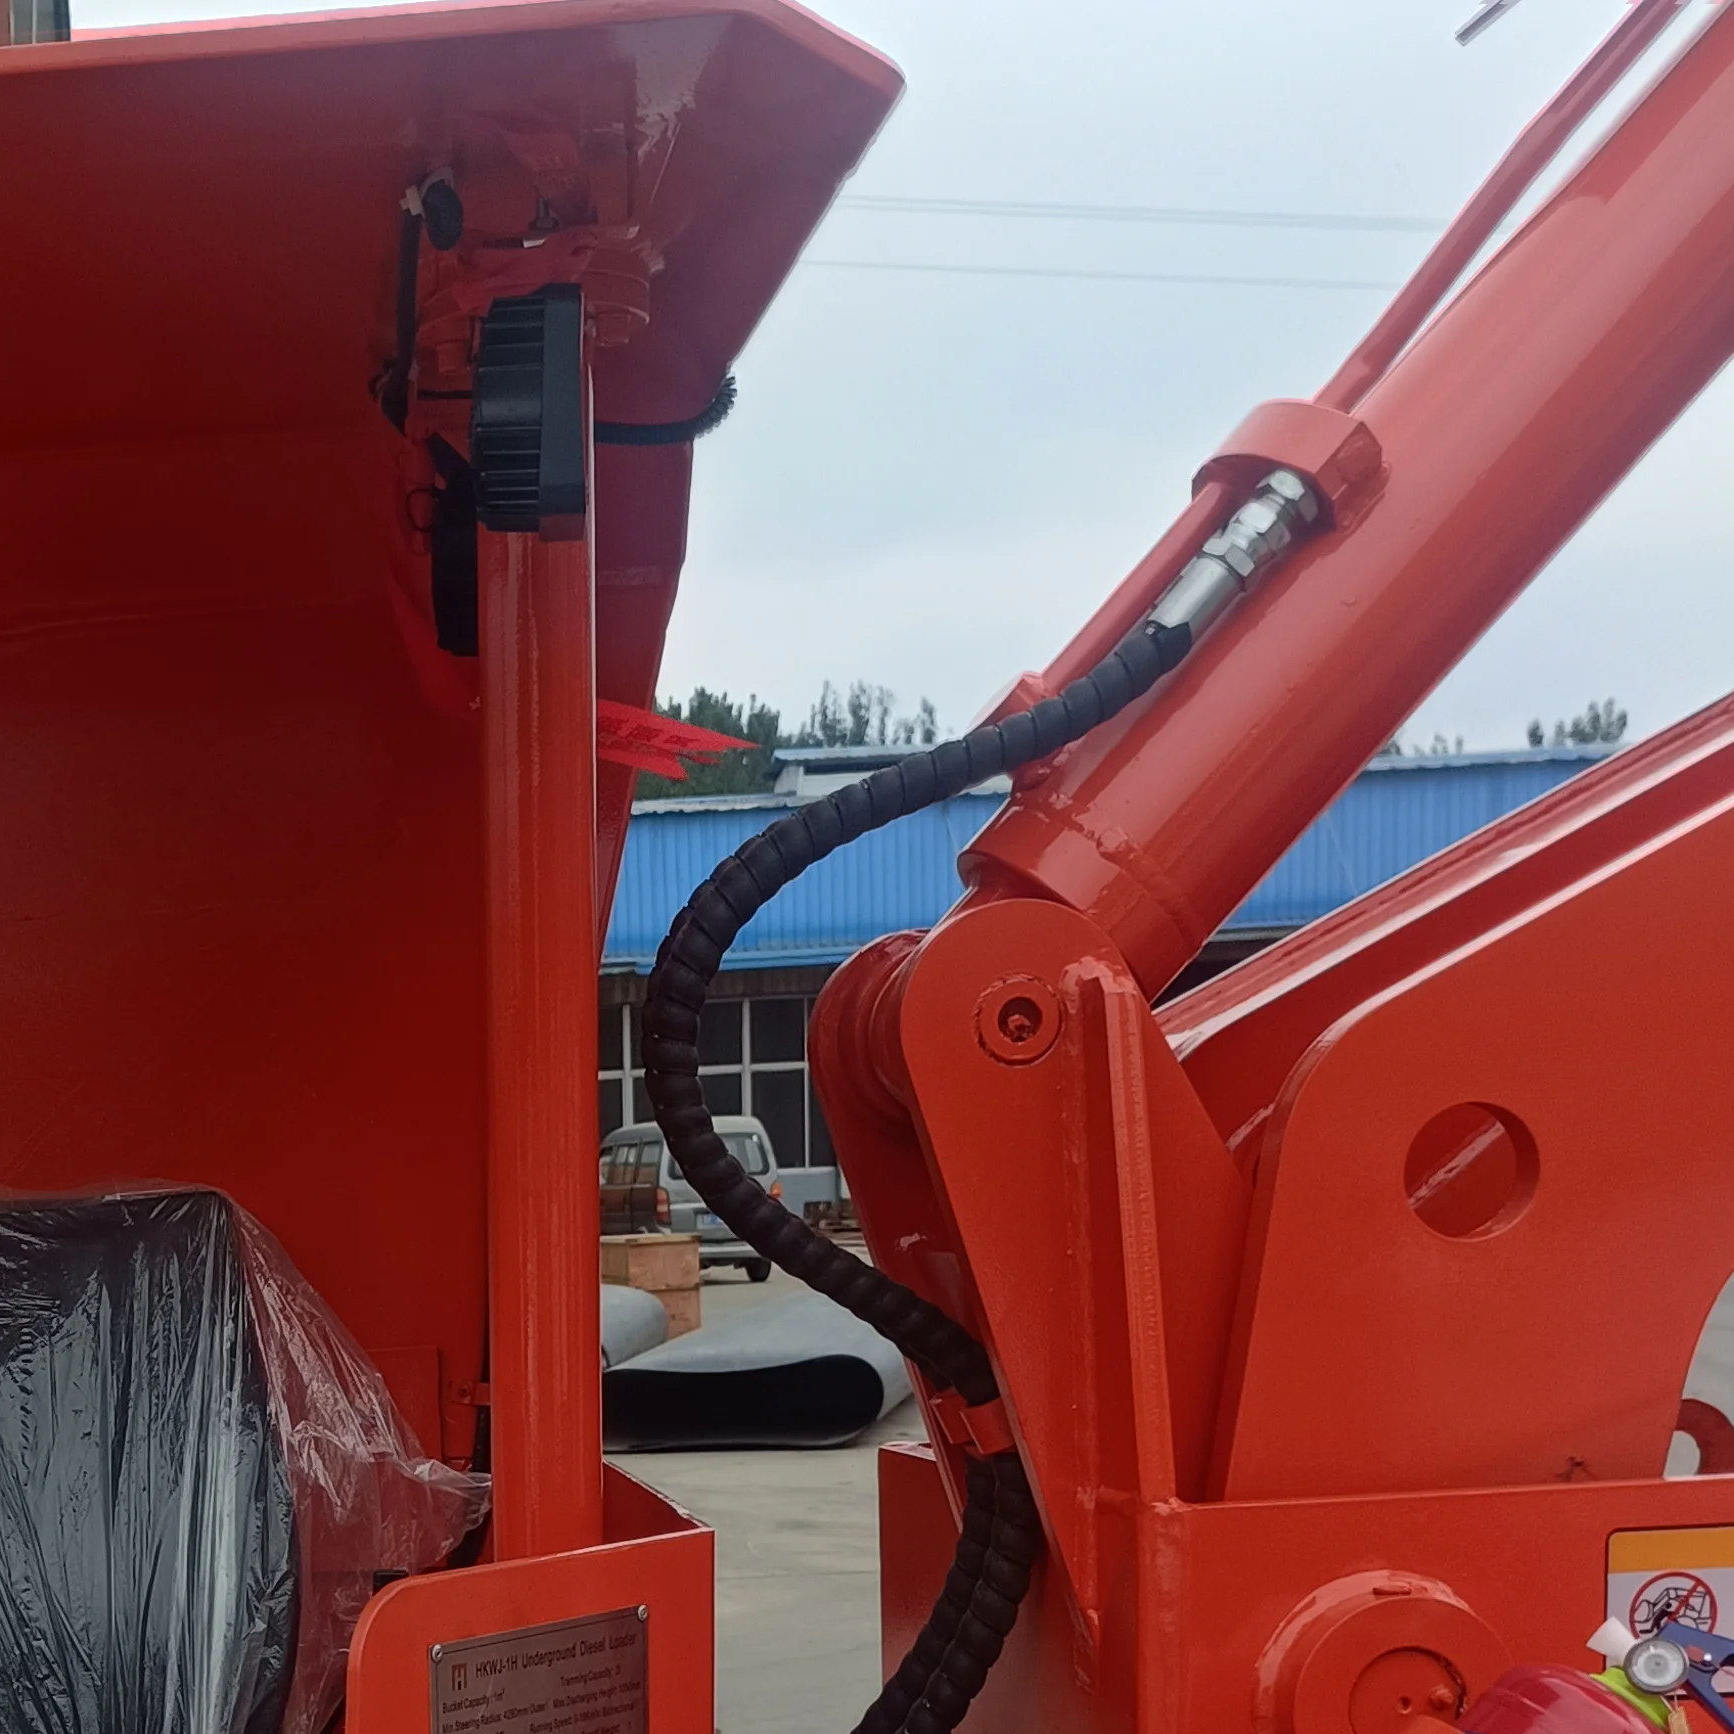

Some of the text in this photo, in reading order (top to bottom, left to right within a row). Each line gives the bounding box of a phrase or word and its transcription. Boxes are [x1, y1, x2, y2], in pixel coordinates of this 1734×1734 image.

[522, 1644, 576, 1668] Underground
[580, 1636, 606, 1656] Diesel
[609, 1633, 637, 1650] Loader
